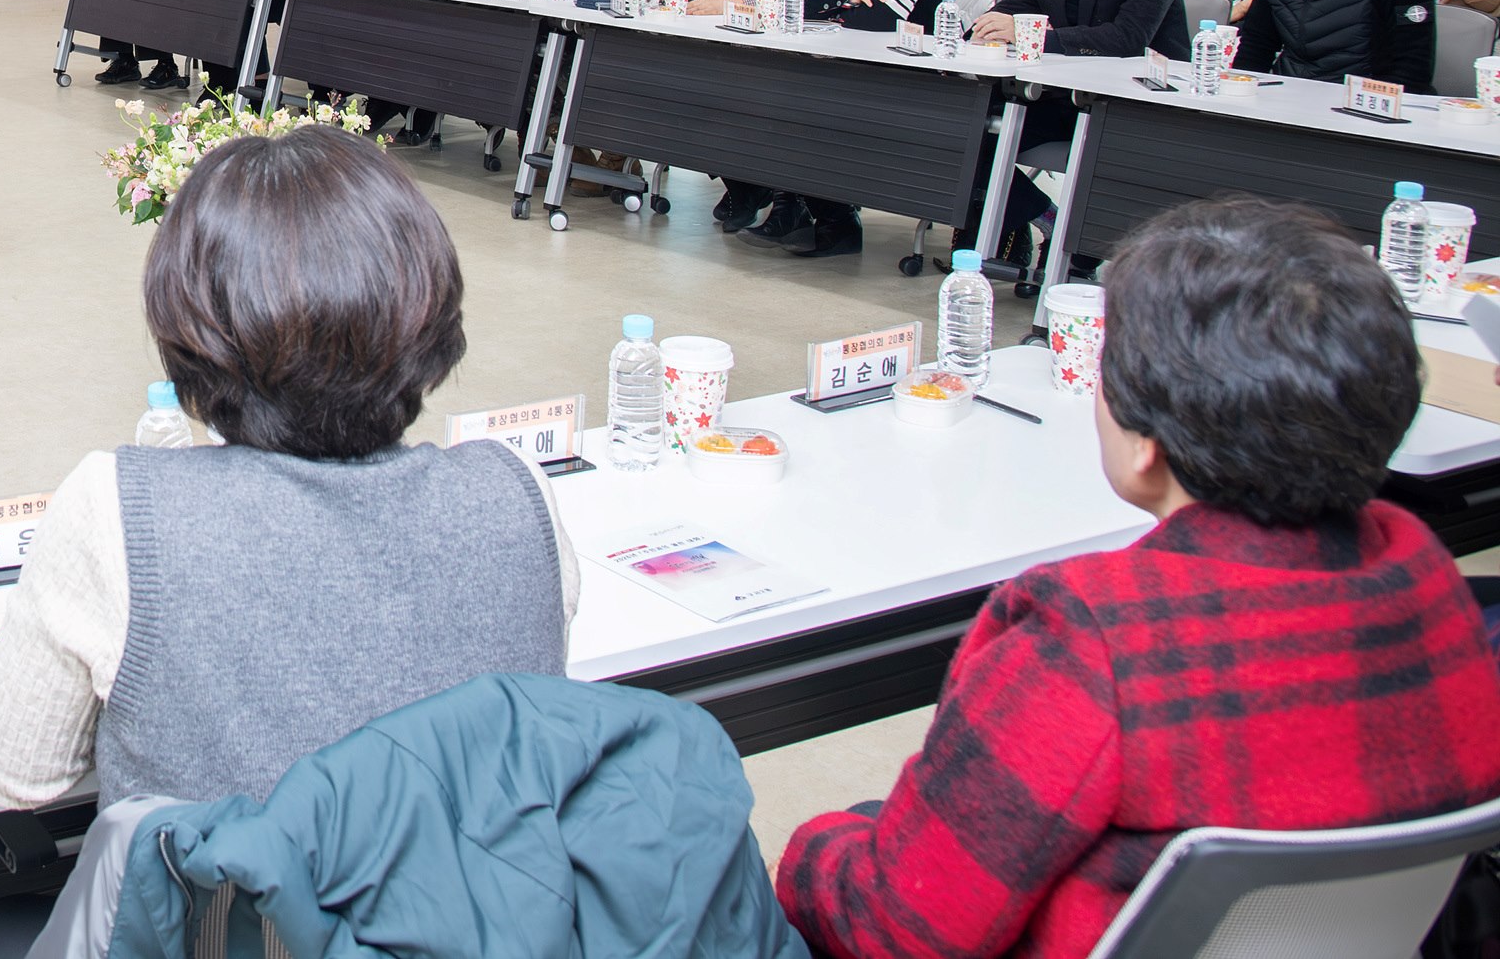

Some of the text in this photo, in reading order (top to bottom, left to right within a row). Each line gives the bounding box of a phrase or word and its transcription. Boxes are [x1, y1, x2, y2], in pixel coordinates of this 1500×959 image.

[842, 337, 884, 355] 통장협의회
[888, 331, 914, 345] 20통장
[488, 408, 540, 428] 통장협의회
[547, 403, 574, 417] 4통장
